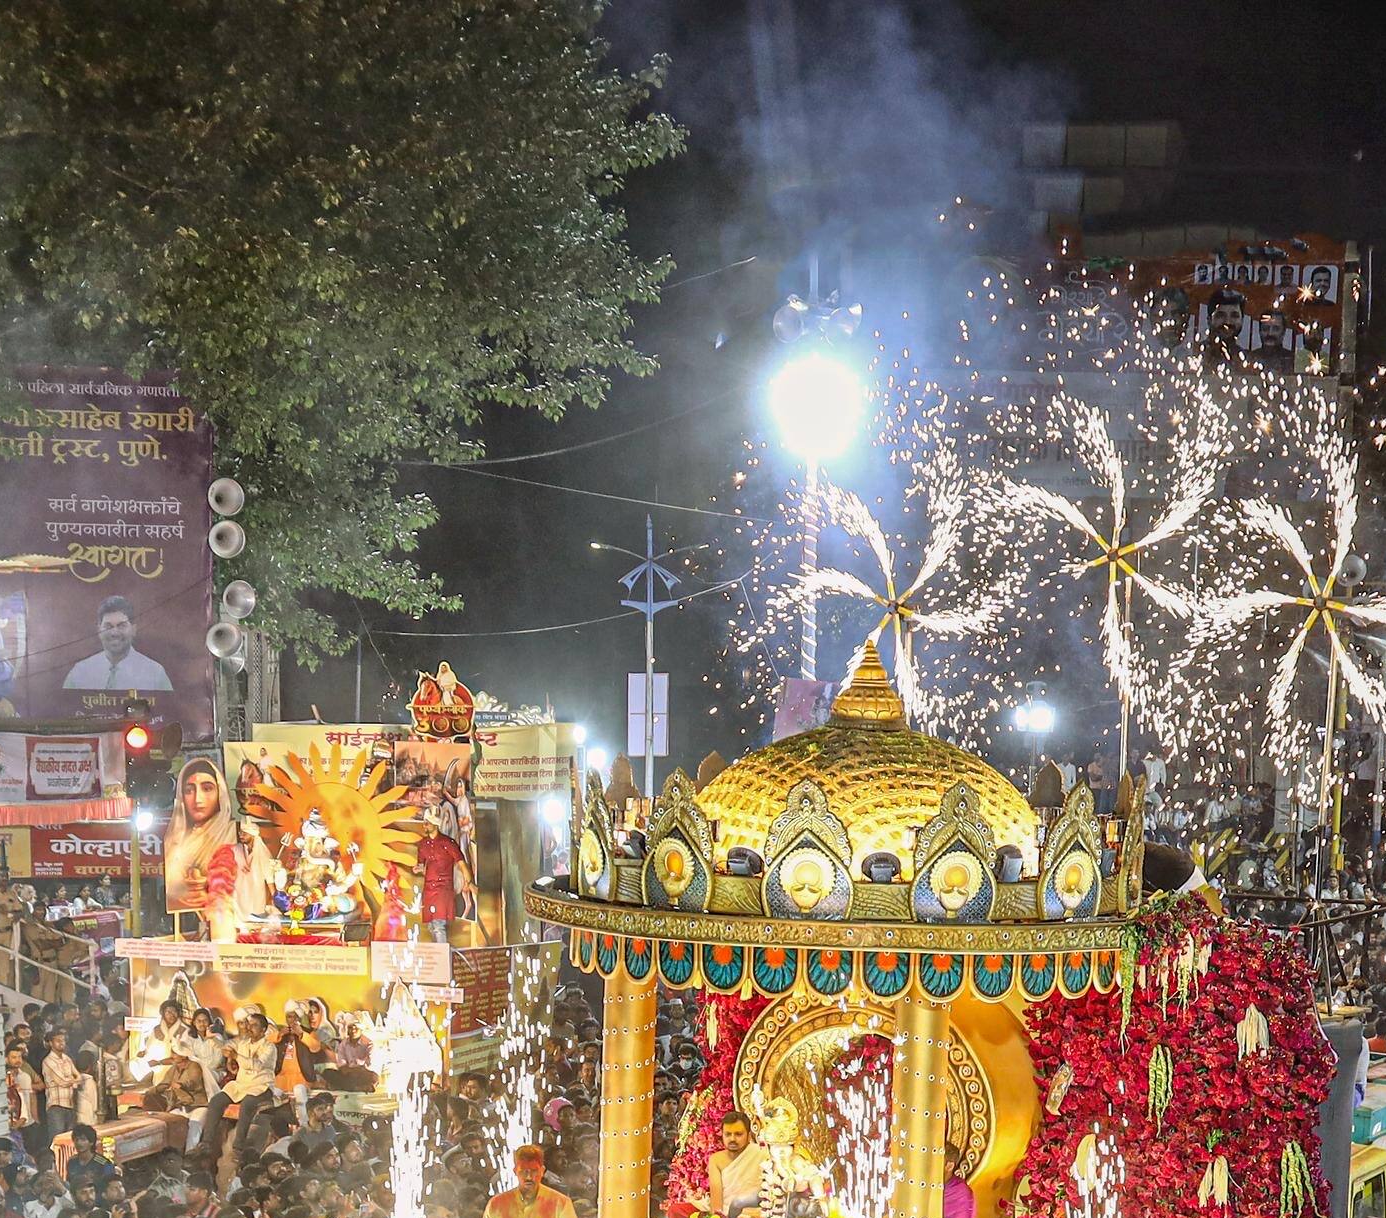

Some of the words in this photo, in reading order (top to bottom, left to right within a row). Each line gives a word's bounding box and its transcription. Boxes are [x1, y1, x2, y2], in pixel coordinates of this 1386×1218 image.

[128, 406, 195, 432] रंगारी
[47, 493, 77, 513] सर्व
[80, 494, 182, 516] गणेशभक्तांचे
[45, 519, 142, 541] पुण्यनगरीत
[144, 520, 185, 540] सहर्ष
[82, 693, 117, 709] पुनीत
